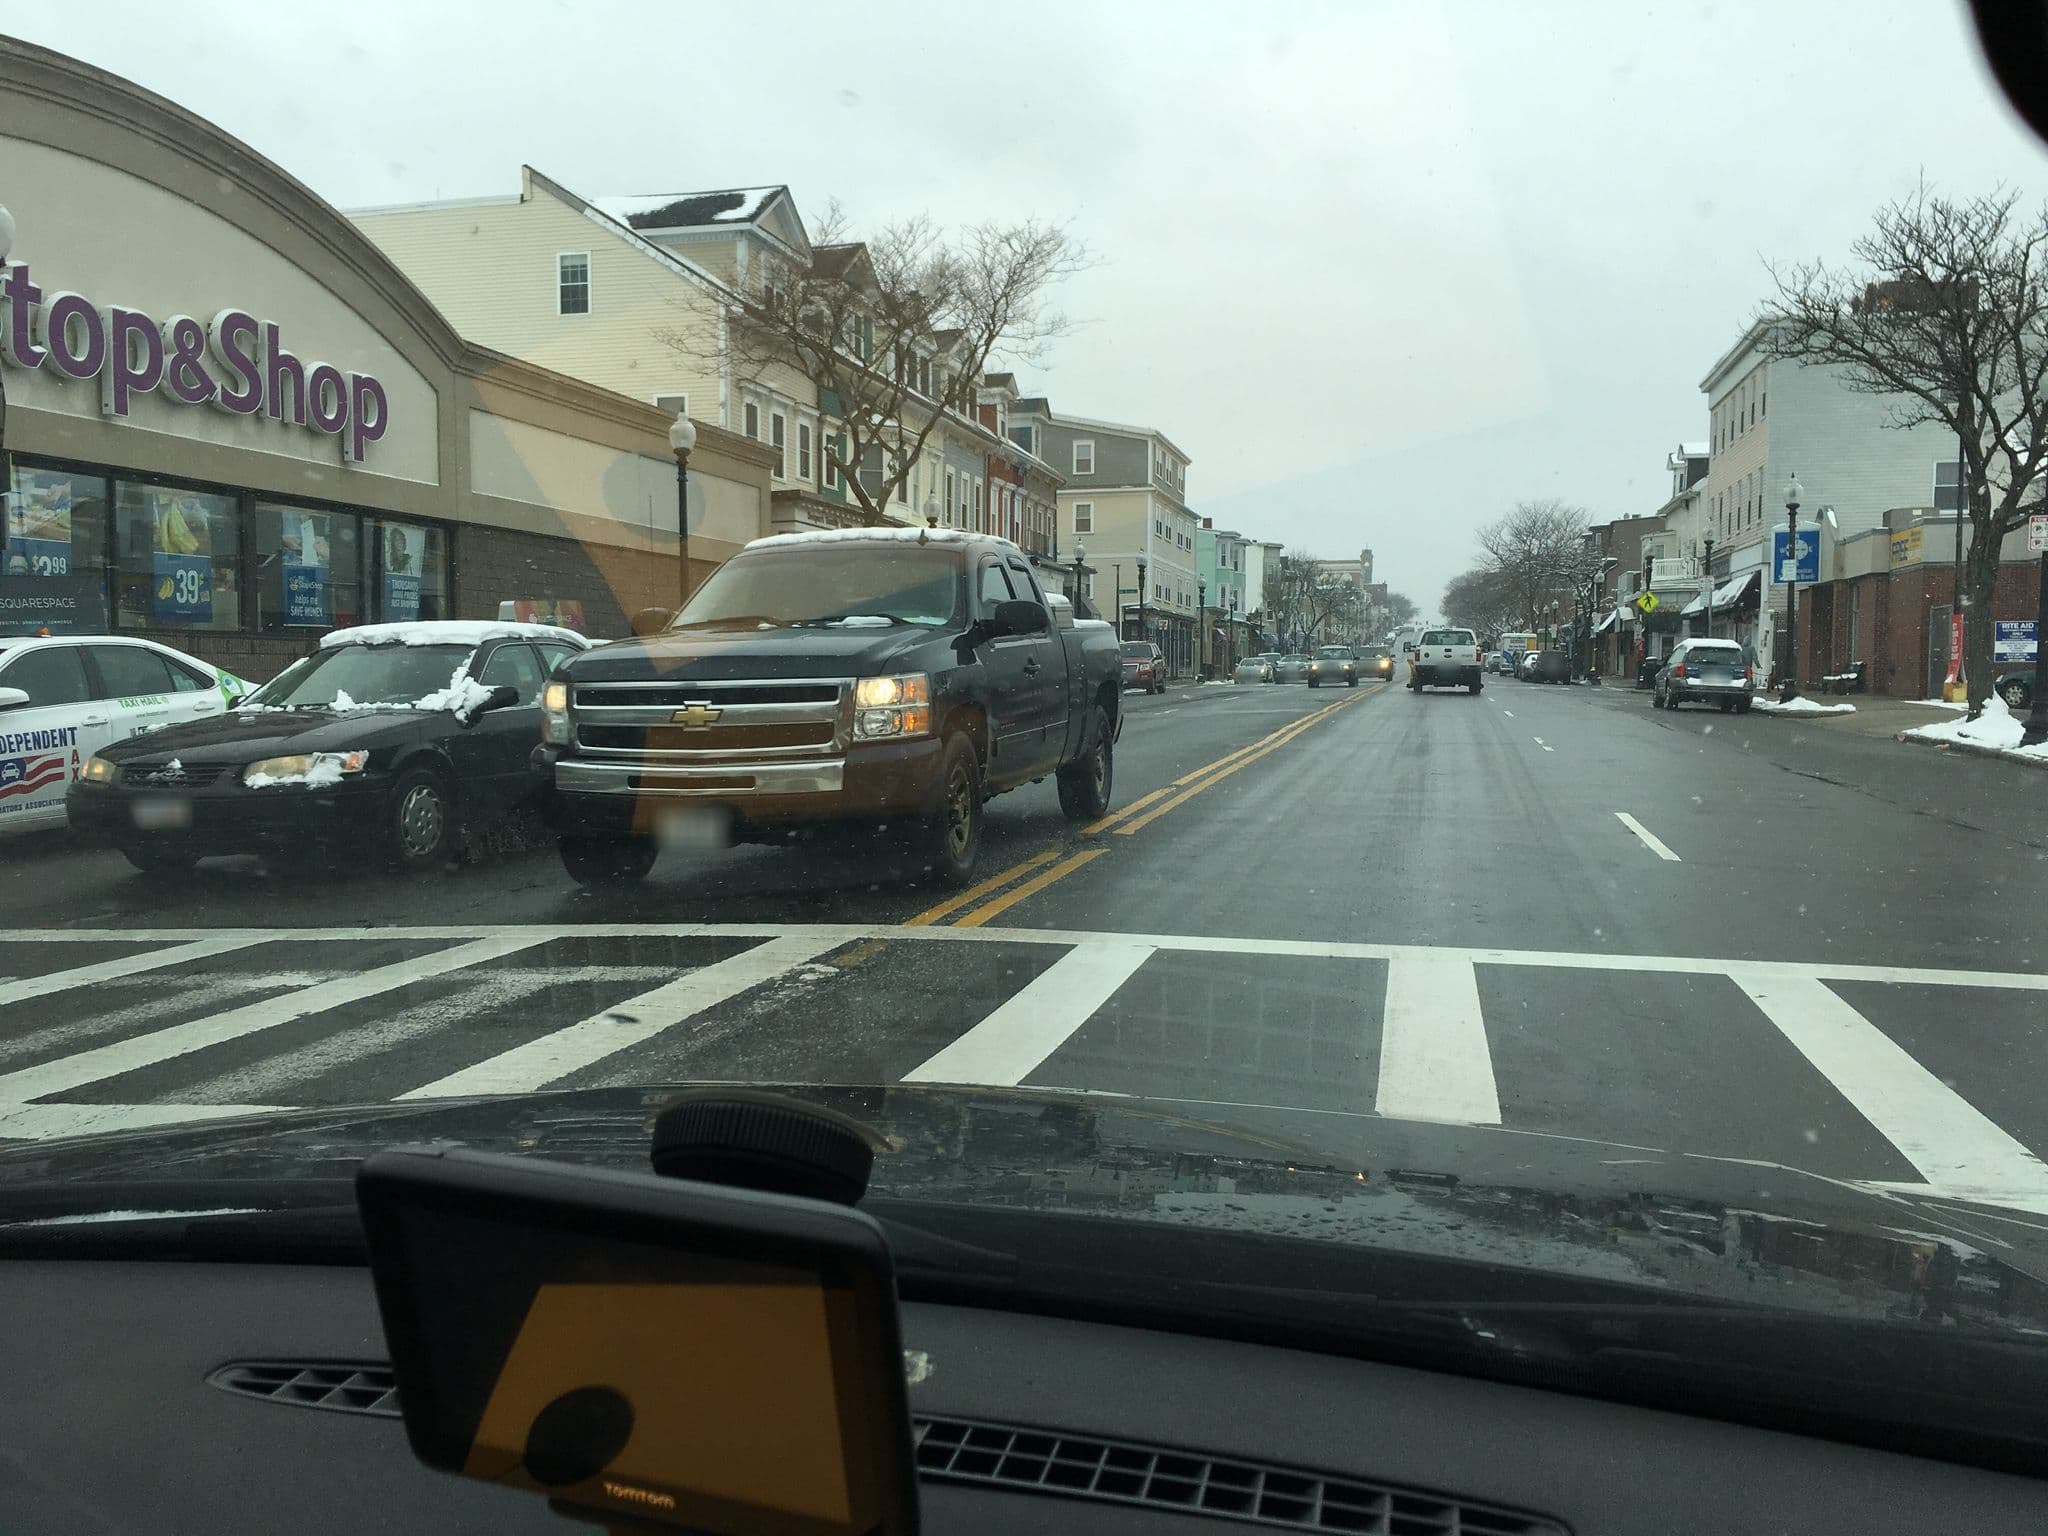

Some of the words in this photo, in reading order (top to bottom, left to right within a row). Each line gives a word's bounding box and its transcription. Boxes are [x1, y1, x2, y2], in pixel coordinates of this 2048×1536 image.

[0, 260, 388, 463] top&Shop
[0, 598, 76, 609] SQUARESPACE
[118, 698, 139, 709] TAXI
